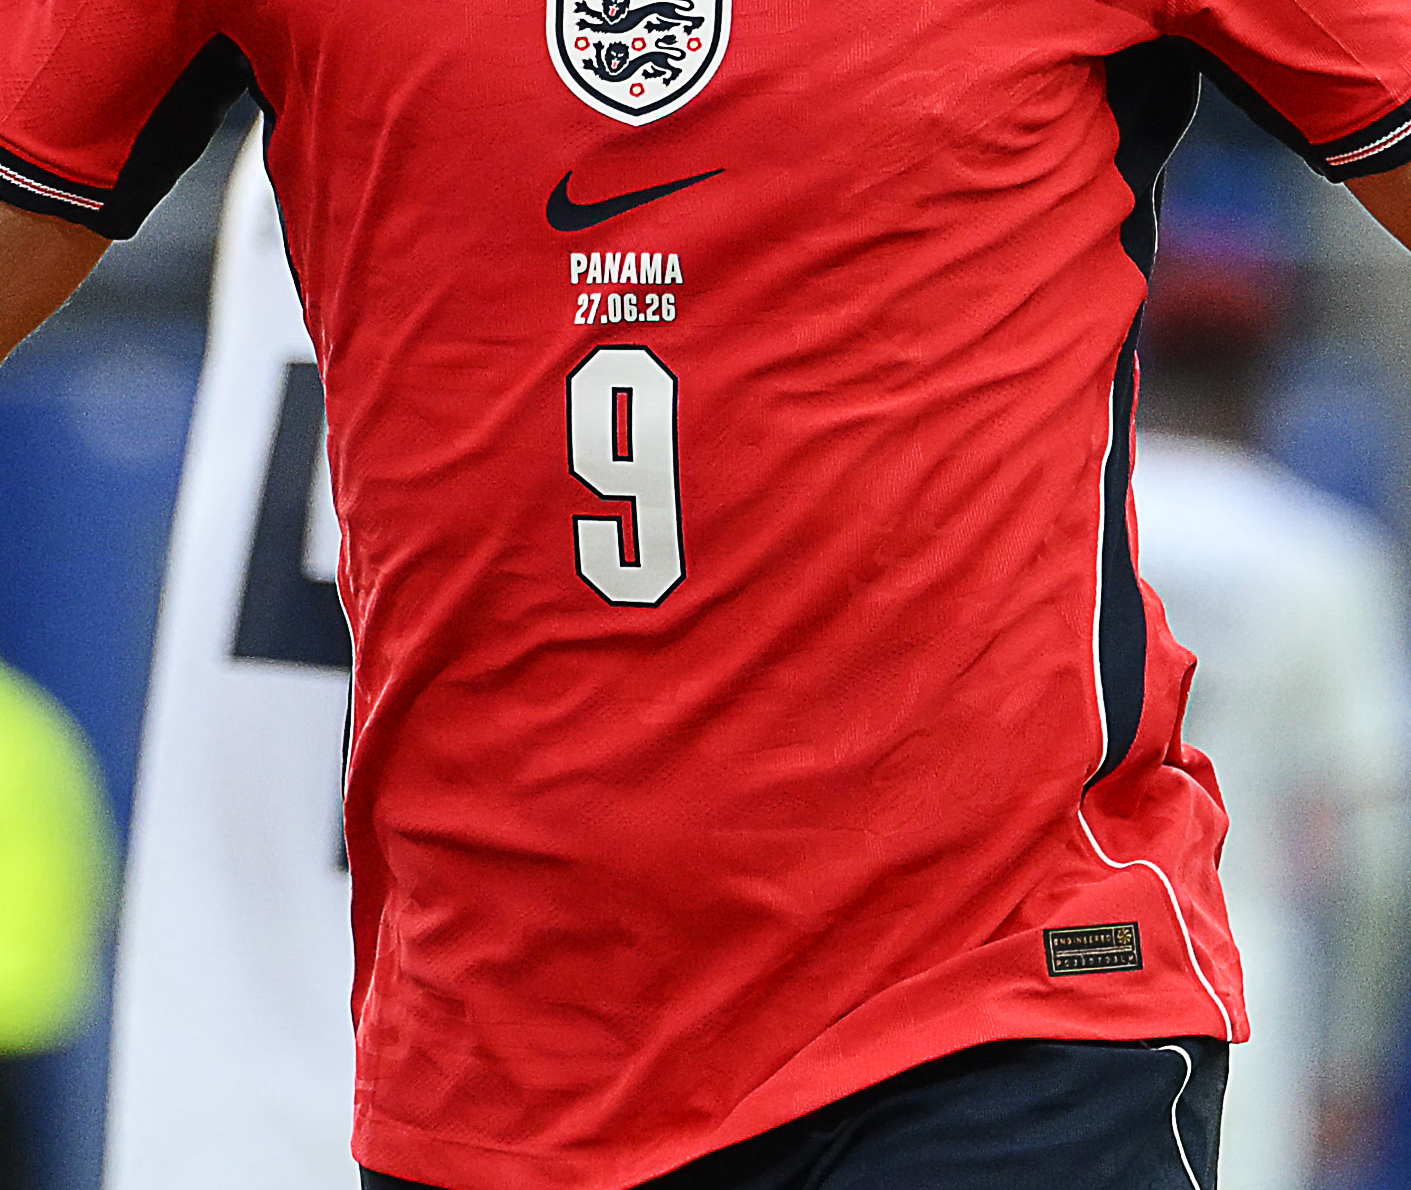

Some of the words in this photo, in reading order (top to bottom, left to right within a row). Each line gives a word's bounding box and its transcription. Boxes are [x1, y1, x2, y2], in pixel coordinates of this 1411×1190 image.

[570, 251, 683, 285] PANAMA
[574, 292, 677, 325] 27.06.26
[567, 345, 686, 608] 9
